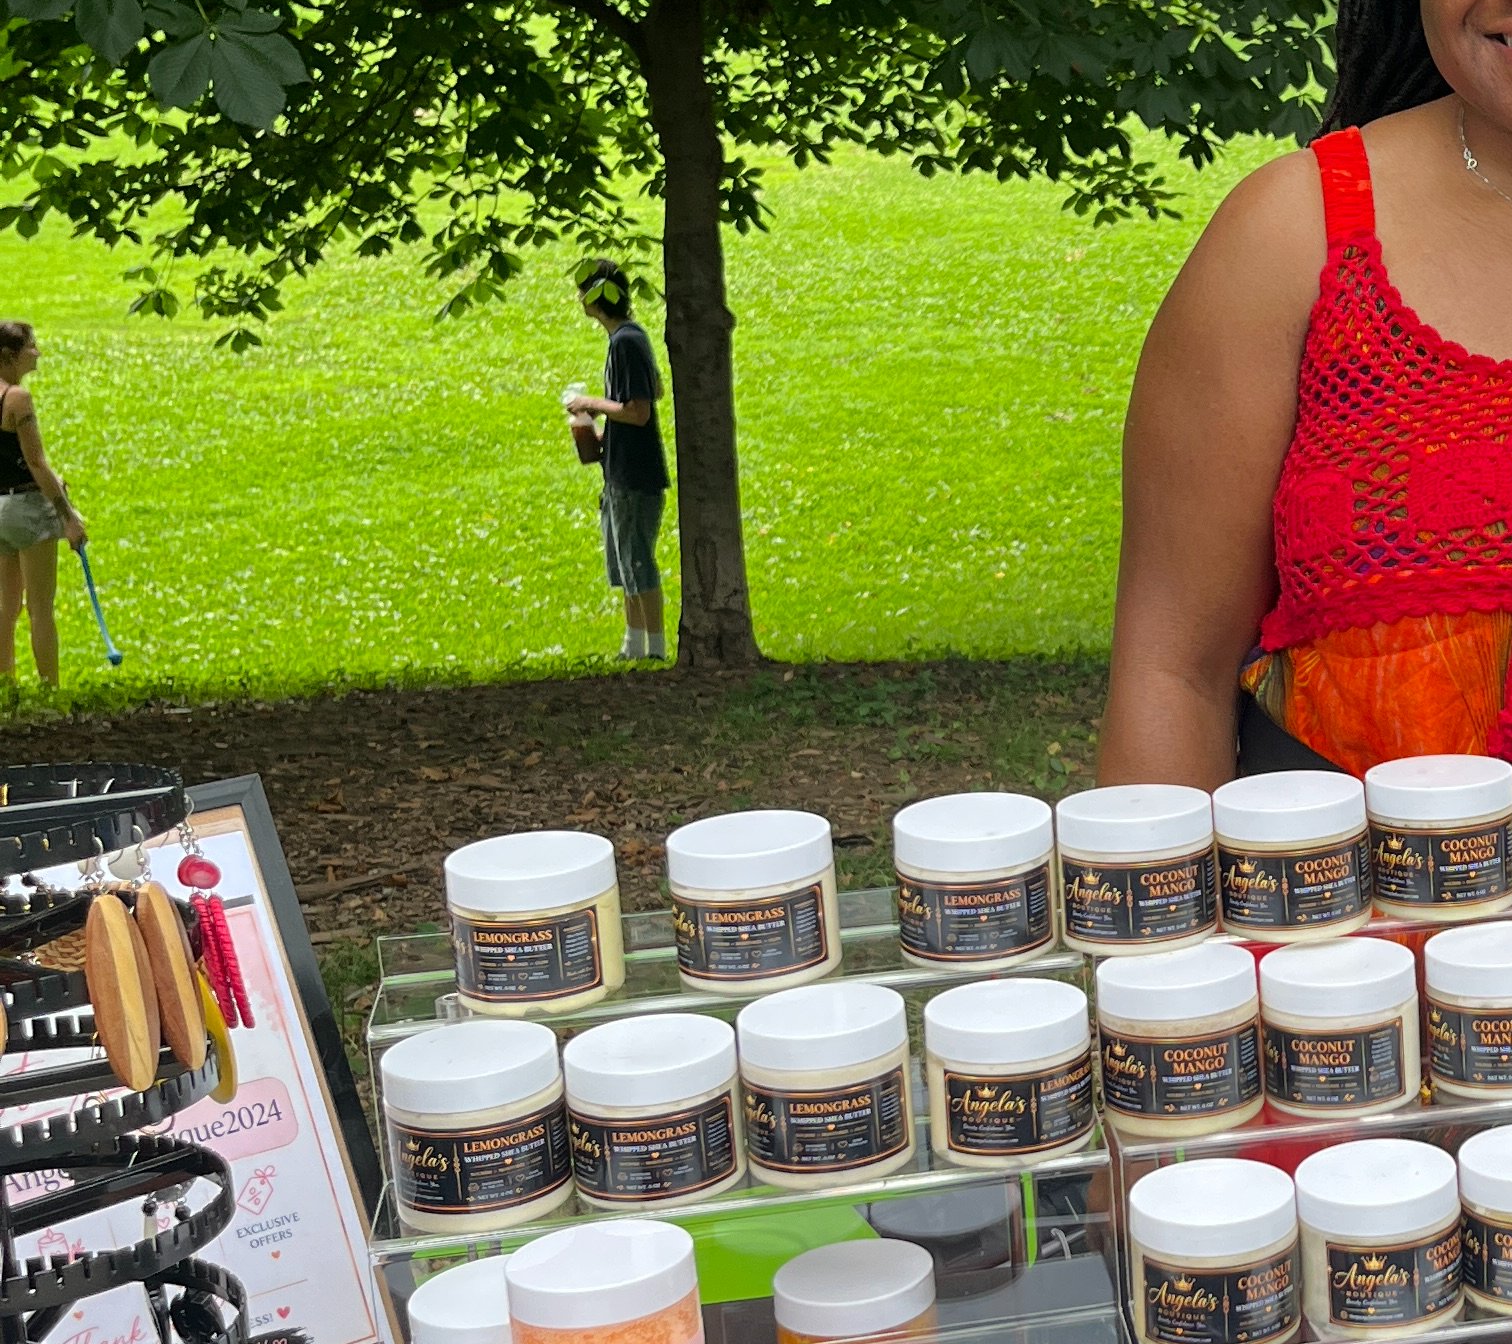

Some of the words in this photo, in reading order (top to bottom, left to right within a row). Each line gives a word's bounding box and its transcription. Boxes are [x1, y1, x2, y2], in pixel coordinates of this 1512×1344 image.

[1440, 835, 1500, 853] COCONUT
[1449, 846, 1496, 864] MANGO
[1295, 851, 1353, 875] COCONUT
[1373, 844, 1424, 871] Angela's
[1139, 865, 1199, 887] COCONUT
[1222, 865, 1279, 890] Angela's
[1303, 864, 1350, 886] MANGO
[943, 887, 1022, 906] LEMONGRASS
[1065, 884, 1123, 908] Angela's
[1148, 878, 1196, 899] MANGO
[704, 907, 785, 924] LEMONGRASS
[473, 928, 553, 945] LEMONGRASS
[1163, 1042, 1229, 1063] COCONUT
[1290, 1039, 1355, 1054] COCONUT
[1172, 1057, 1226, 1075] MANGO
[1299, 1052, 1351, 1066] MANGO
[1039, 1064, 1092, 1092] LEMONGRA
[788, 1094, 872, 1116] LEMONGRASS
[951, 1088, 1028, 1119] Angela's
[463, 1124, 546, 1154] LEMONGRASS
[611, 1122, 697, 1144] LEMONGRASS
[402, 1146, 451, 1172] ngela's
[236, 1211, 301, 1239] EXCLUSIVE
[249, 1227, 294, 1249] OFFERS
[1237, 1259, 1293, 1291] COCONUT
[1334, 1263, 1411, 1292] Angela's
[1149, 1284, 1219, 1313] Angela's
[1245, 1274, 1290, 1301] MANGO
